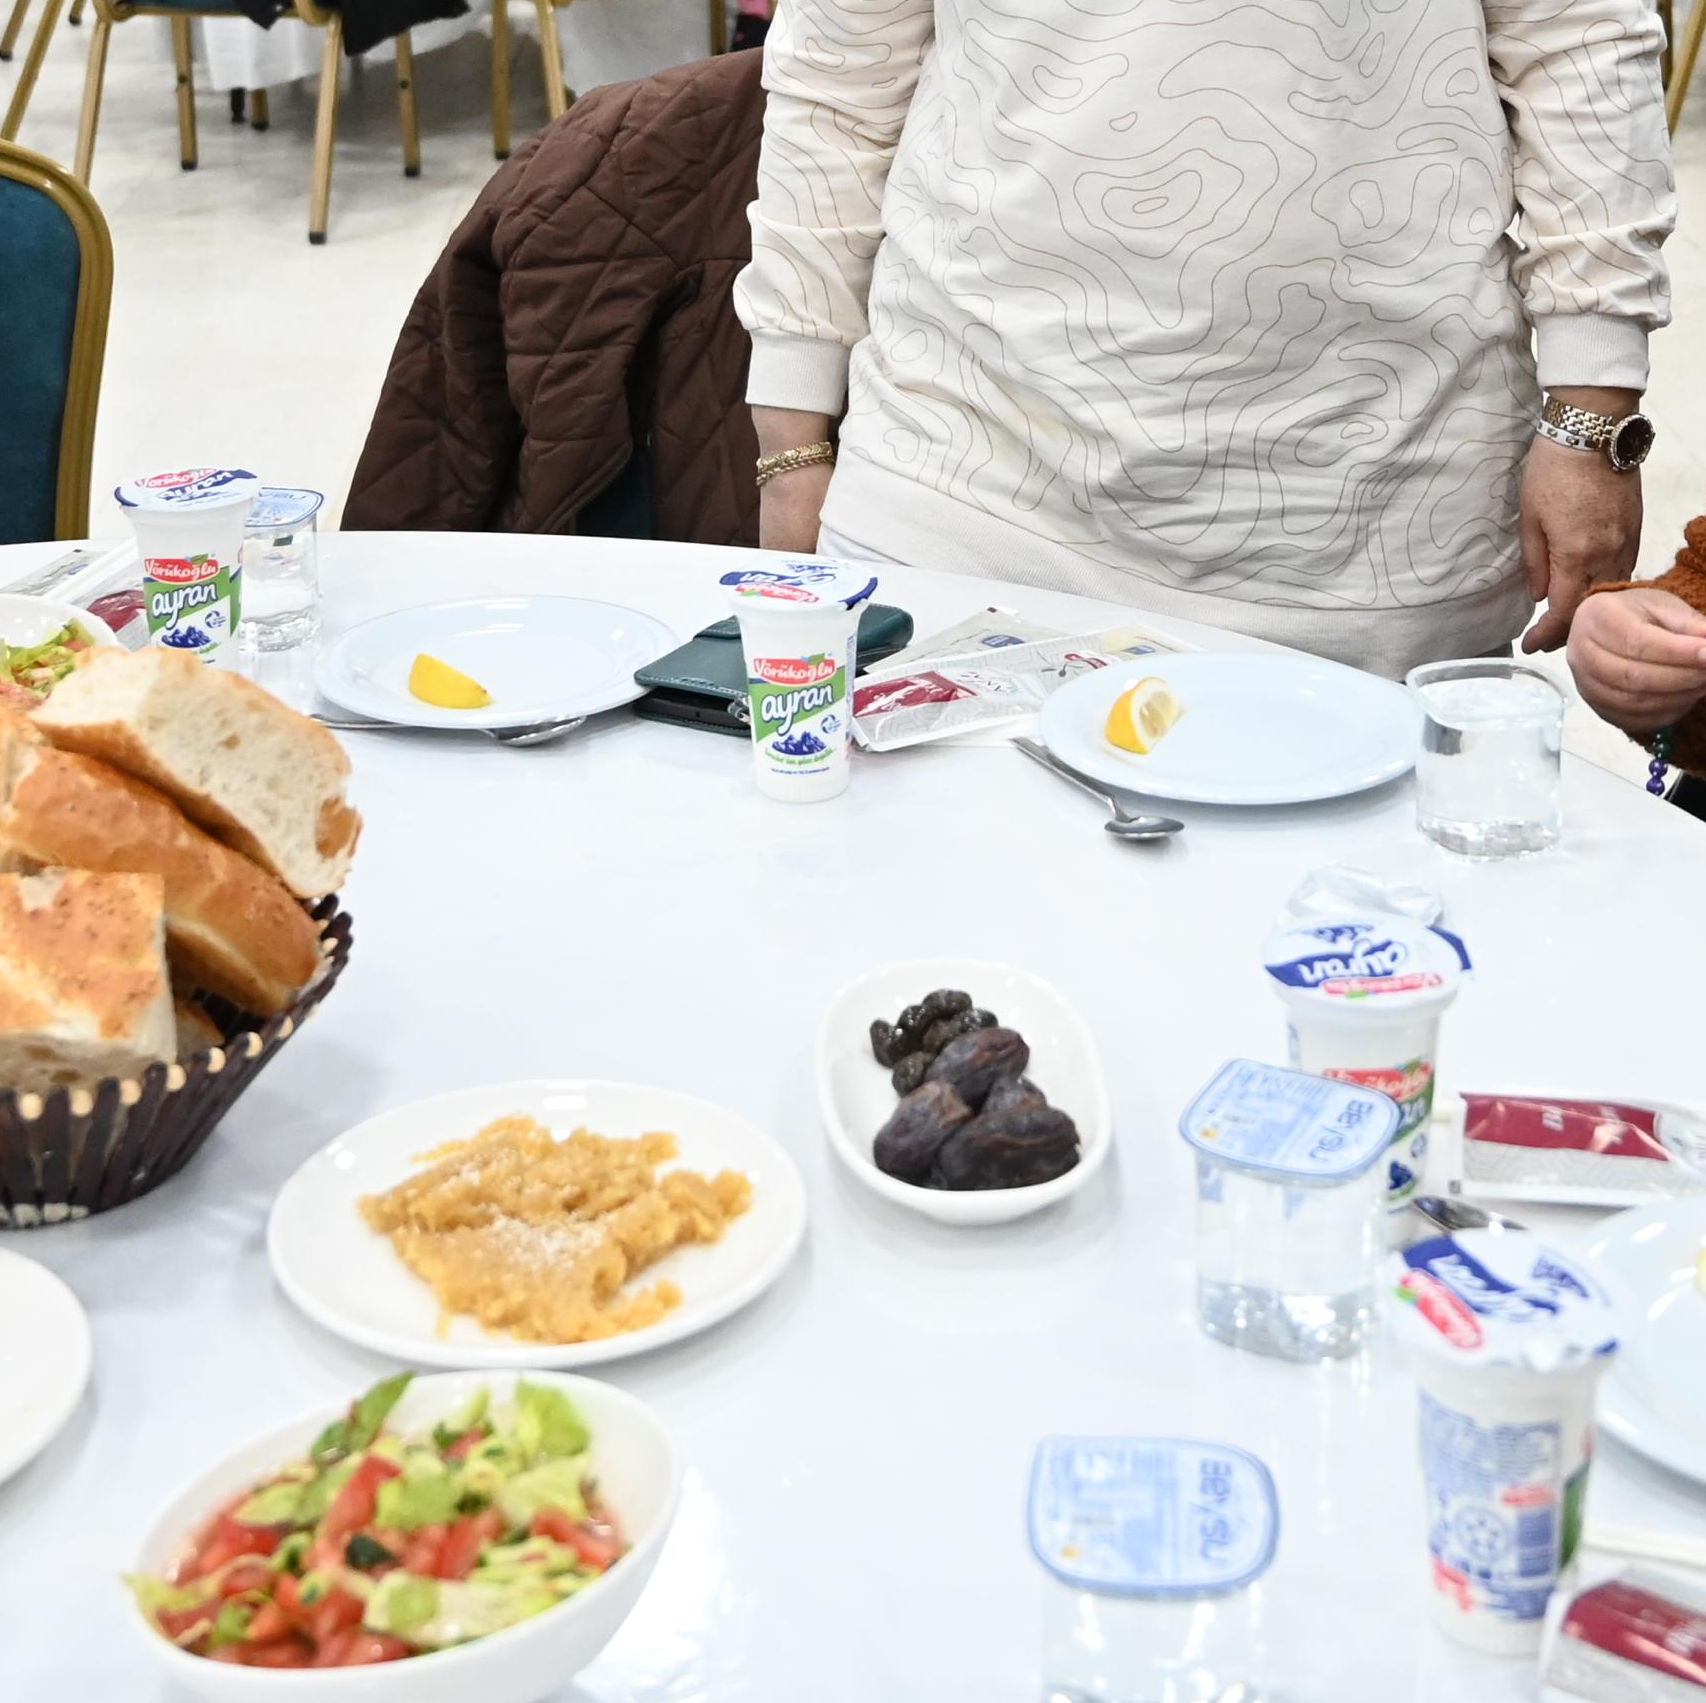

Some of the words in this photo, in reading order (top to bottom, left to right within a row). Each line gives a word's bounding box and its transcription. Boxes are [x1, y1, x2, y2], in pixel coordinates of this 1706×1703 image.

[144, 559, 218, 581] Yörükoğlu
[151, 583, 217, 629] ayran
[754, 659, 835, 683] Yörükoğlu
[761, 685, 834, 736] ayran
[1299, 938, 1409, 983] ayran
